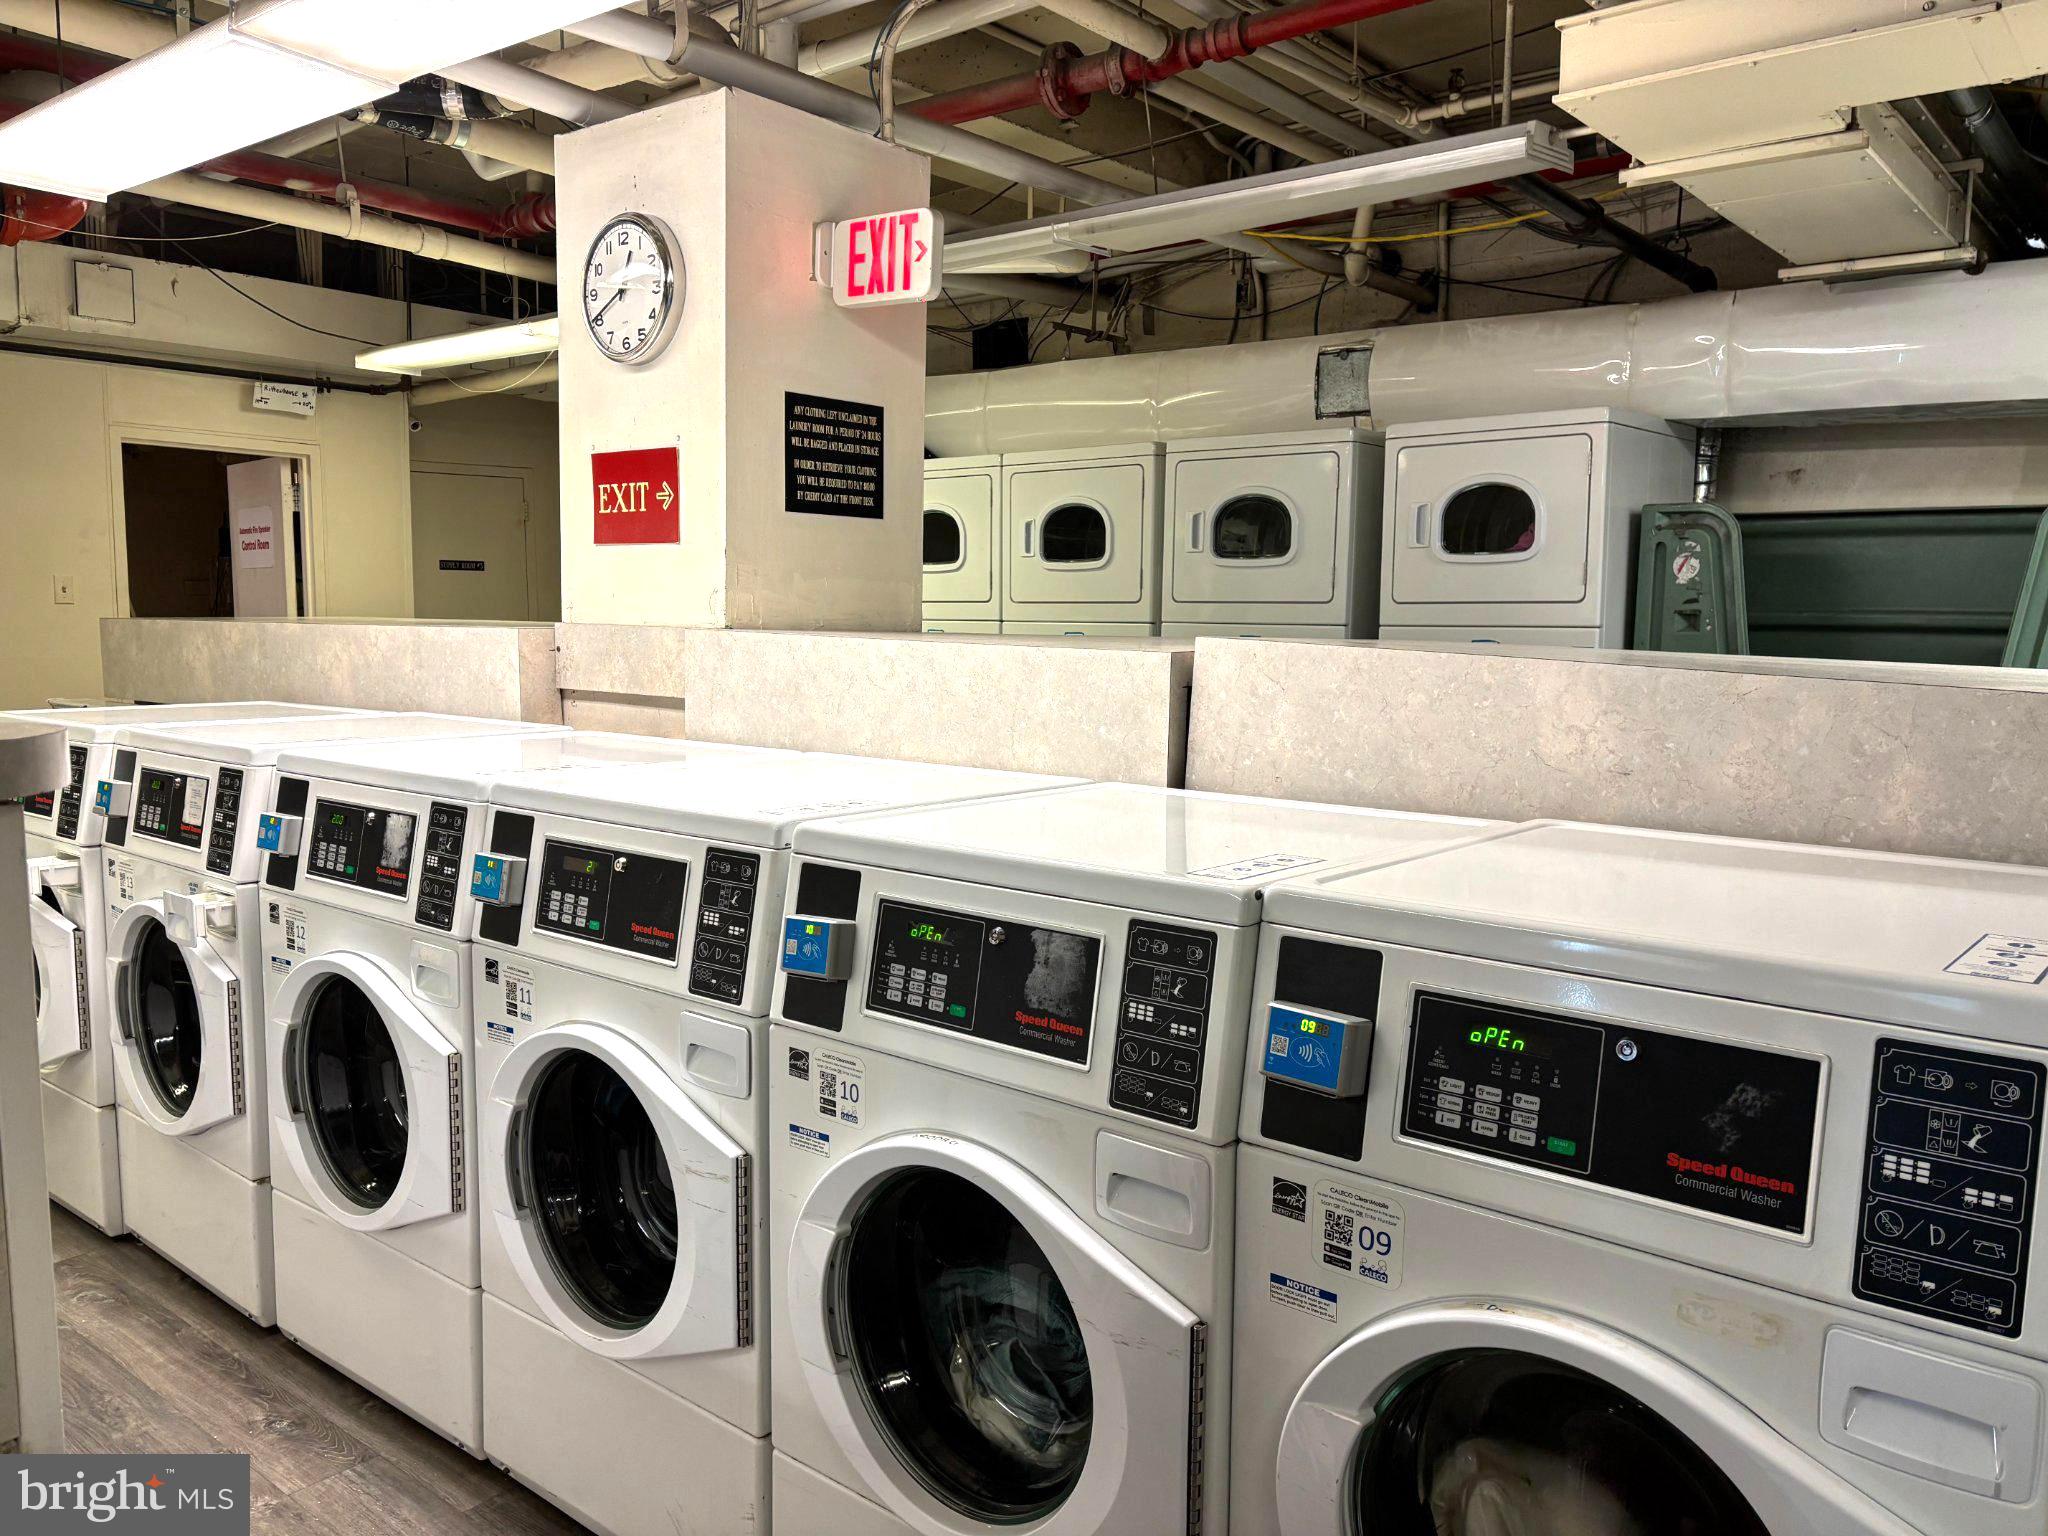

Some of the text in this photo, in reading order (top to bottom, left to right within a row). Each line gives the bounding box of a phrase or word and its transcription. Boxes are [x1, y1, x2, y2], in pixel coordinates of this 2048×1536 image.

[618, 232, 629, 246] 12
[647, 254, 656, 267] 2
[848, 213, 919, 297] EXIT
[595, 263, 603, 277] 10
[652, 280, 661, 294] 3
[595, 314, 604, 326] 8
[638, 328, 647, 342] 5
[622, 337, 631, 350] 6
[790, 420, 811, 433] LAUNDRY
[813, 424, 825, 434] ROOM
[791, 437, 803, 447] WILL
[598, 482, 649, 514] EXIT
[821, 493, 833, 502] CARD
[297, 926, 305, 940] 12
[632, 923, 674, 940] Speed Queen
[520, 988, 532, 1005] 11
[1016, 1011, 1084, 1036] Speed Queen
[1301, 1019, 1316, 1033] 09
[1020, 1026, 1076, 1047] Commercial Washer
[841, 1081, 859, 1103] 10
[799, 1128, 820, 1138] NOTICE
[1667, 1153, 1795, 1194] Speed Queen
[1330, 1187, 1353, 1199] CALECO
[1675, 1174, 1782, 1209] Commercial Washer
[1359, 1226, 1391, 1256] 09
[1360, 1268, 1387, 1281] CALECO
[1287, 1280, 1320, 1296] NOTICE
